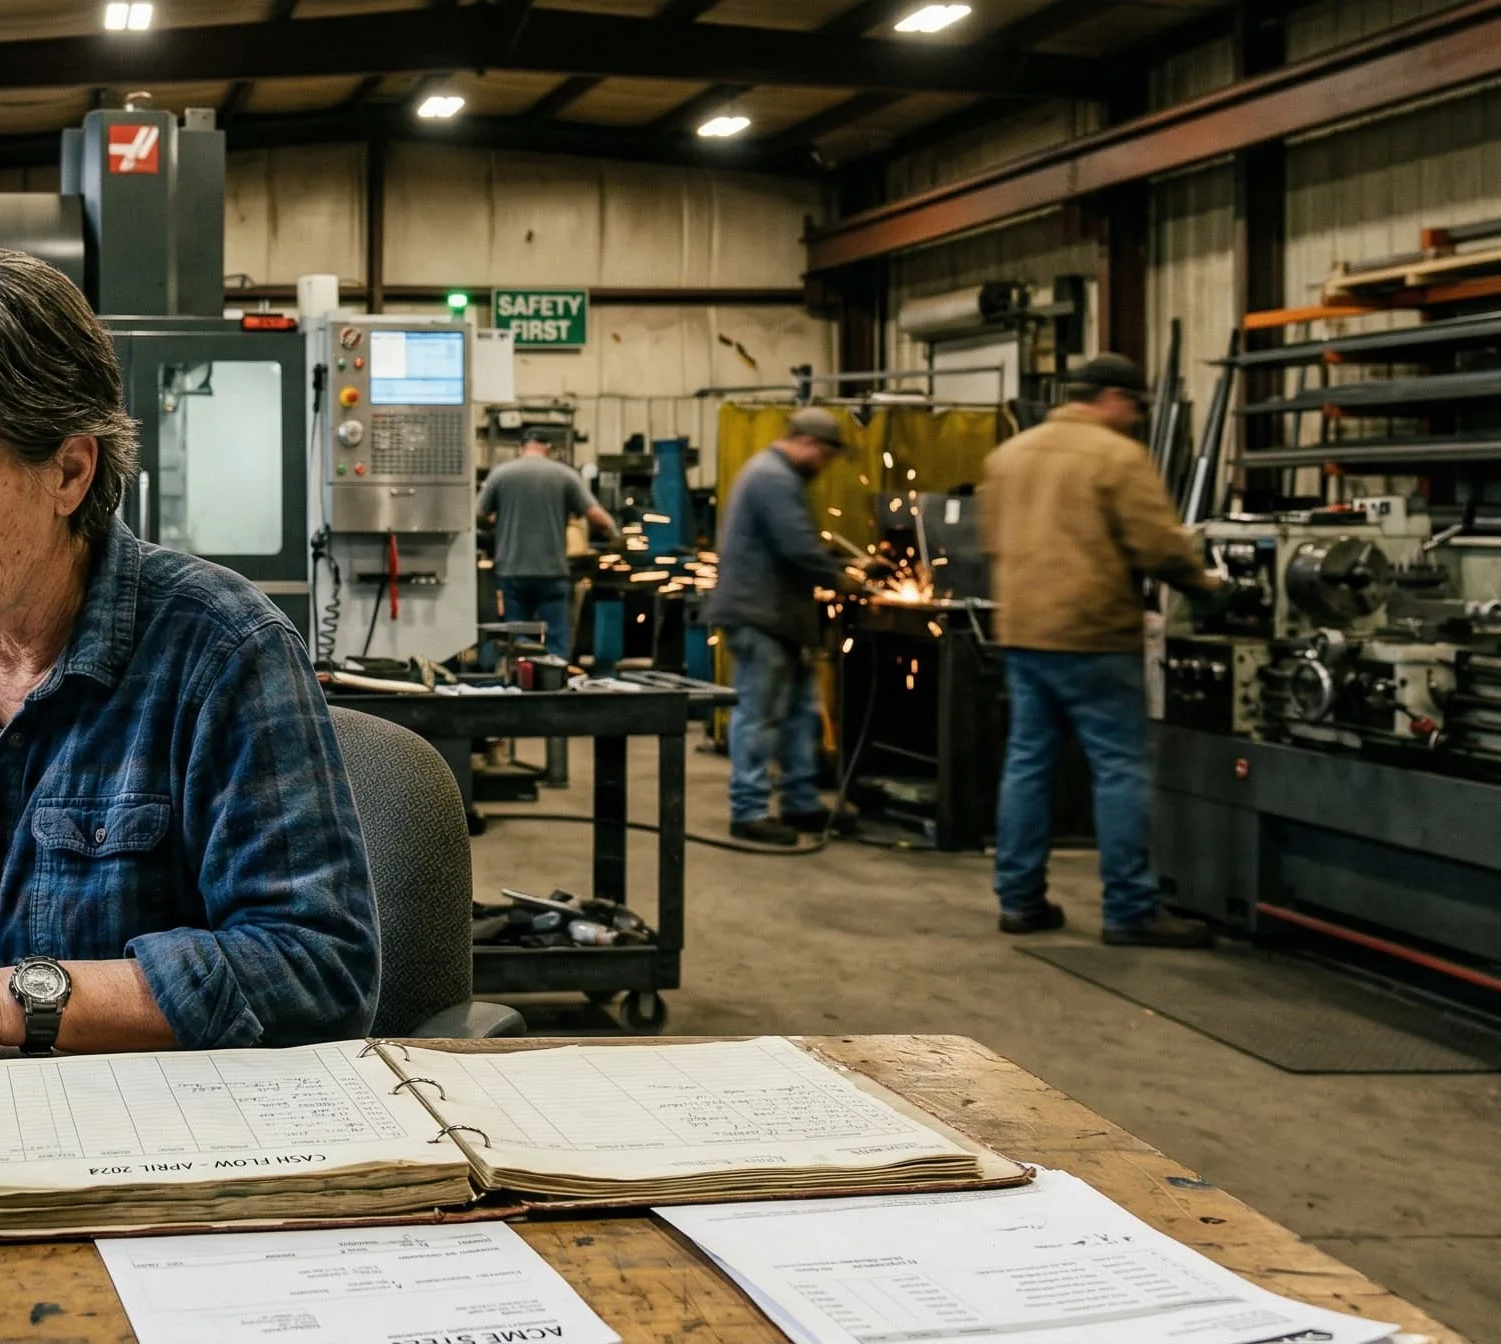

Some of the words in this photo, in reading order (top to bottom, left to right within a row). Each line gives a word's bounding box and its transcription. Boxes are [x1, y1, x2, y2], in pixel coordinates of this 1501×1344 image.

[498, 294, 582, 316] SAFETY
[510, 319, 572, 341] FIRST
[214, 1156, 270, 1168] FLOW
[276, 1154, 327, 1165] CASH
[138, 1162, 193, 1173] APRIL
[481, 1326, 563, 1344] ACME
